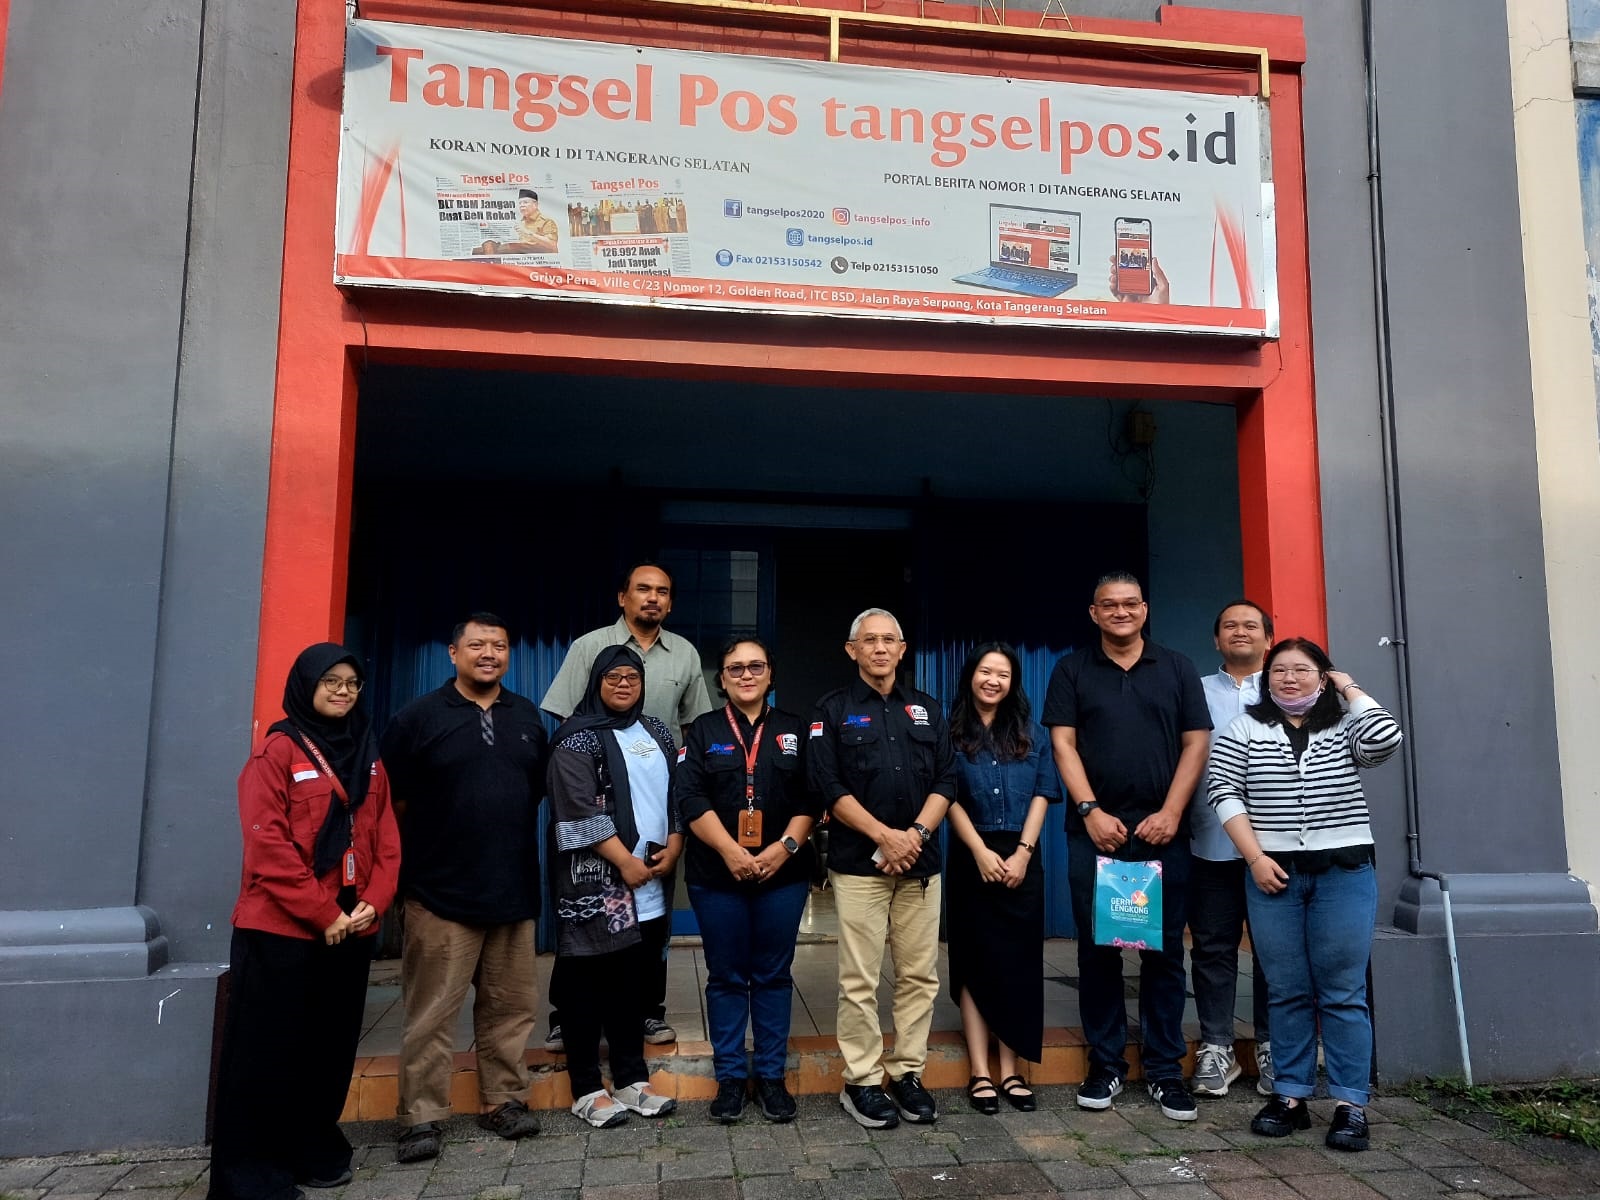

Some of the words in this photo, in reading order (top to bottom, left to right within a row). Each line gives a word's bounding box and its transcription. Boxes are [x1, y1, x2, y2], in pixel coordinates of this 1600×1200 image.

[375, 45, 654, 133] Tangsel
[678, 73, 799, 136] Pos
[822, 97, 1237, 175] tangselpos.id
[429, 137, 487, 154] KORAN
[490, 142, 552, 159] NOMOR
[554, 147, 562, 159] 1
[565, 147, 582, 161] DI
[585, 148, 681, 169] TANGERANG
[683, 156, 751, 174] SELATAN
[461, 173, 505, 187] Tangsel
[508, 173, 529, 184] Pos
[591, 178, 635, 192] Tangsel
[637, 178, 659, 189] Pos
[883, 173, 931, 187] PORTAL
[934, 176, 977, 190] BERITA
[979, 179, 1027, 193] NOMOR
[1030, 182, 1035, 193] 1
[1038, 183, 1052, 195] DI
[1053, 184, 1128, 200] TANGERANG
[1130, 189, 1181, 203] SELATAN
[480, 200, 516, 211] Jangan
[746, 205, 825, 219] tangselpos2020
[486, 210, 517, 221] Rokok
[854, 214, 931, 226] tangselpos_info
[808, 233, 874, 246] tangselpos.id
[736, 254, 753, 265] Fax
[755, 256, 823, 268] 02153150542
[851, 261, 872, 272] Telp
[873, 263, 939, 275] 02153151050
[529, 271, 563, 287] Griya
[567, 273, 598, 290] Pena,
[602, 275, 631, 290] Ville
[633, 276, 661, 292] C/23
[663, 280, 706, 294] Nomor
[709, 282, 726, 297] 12,
[728, 283, 771, 298] Golden
[773, 286, 806, 302] Road,
[810, 290, 828, 301] ITC
[831, 291, 857, 304] BSD,
[860, 292, 890, 306] Jalan
[893, 294, 920, 309] Raya
[923, 297, 973, 312] Serpong,
[976, 298, 1002, 311] Kota
[1003, 299, 1063, 316] Tangerang
[1066, 303, 1107, 315] Selatan
[1111, 904, 1149, 915] LENGKONG
